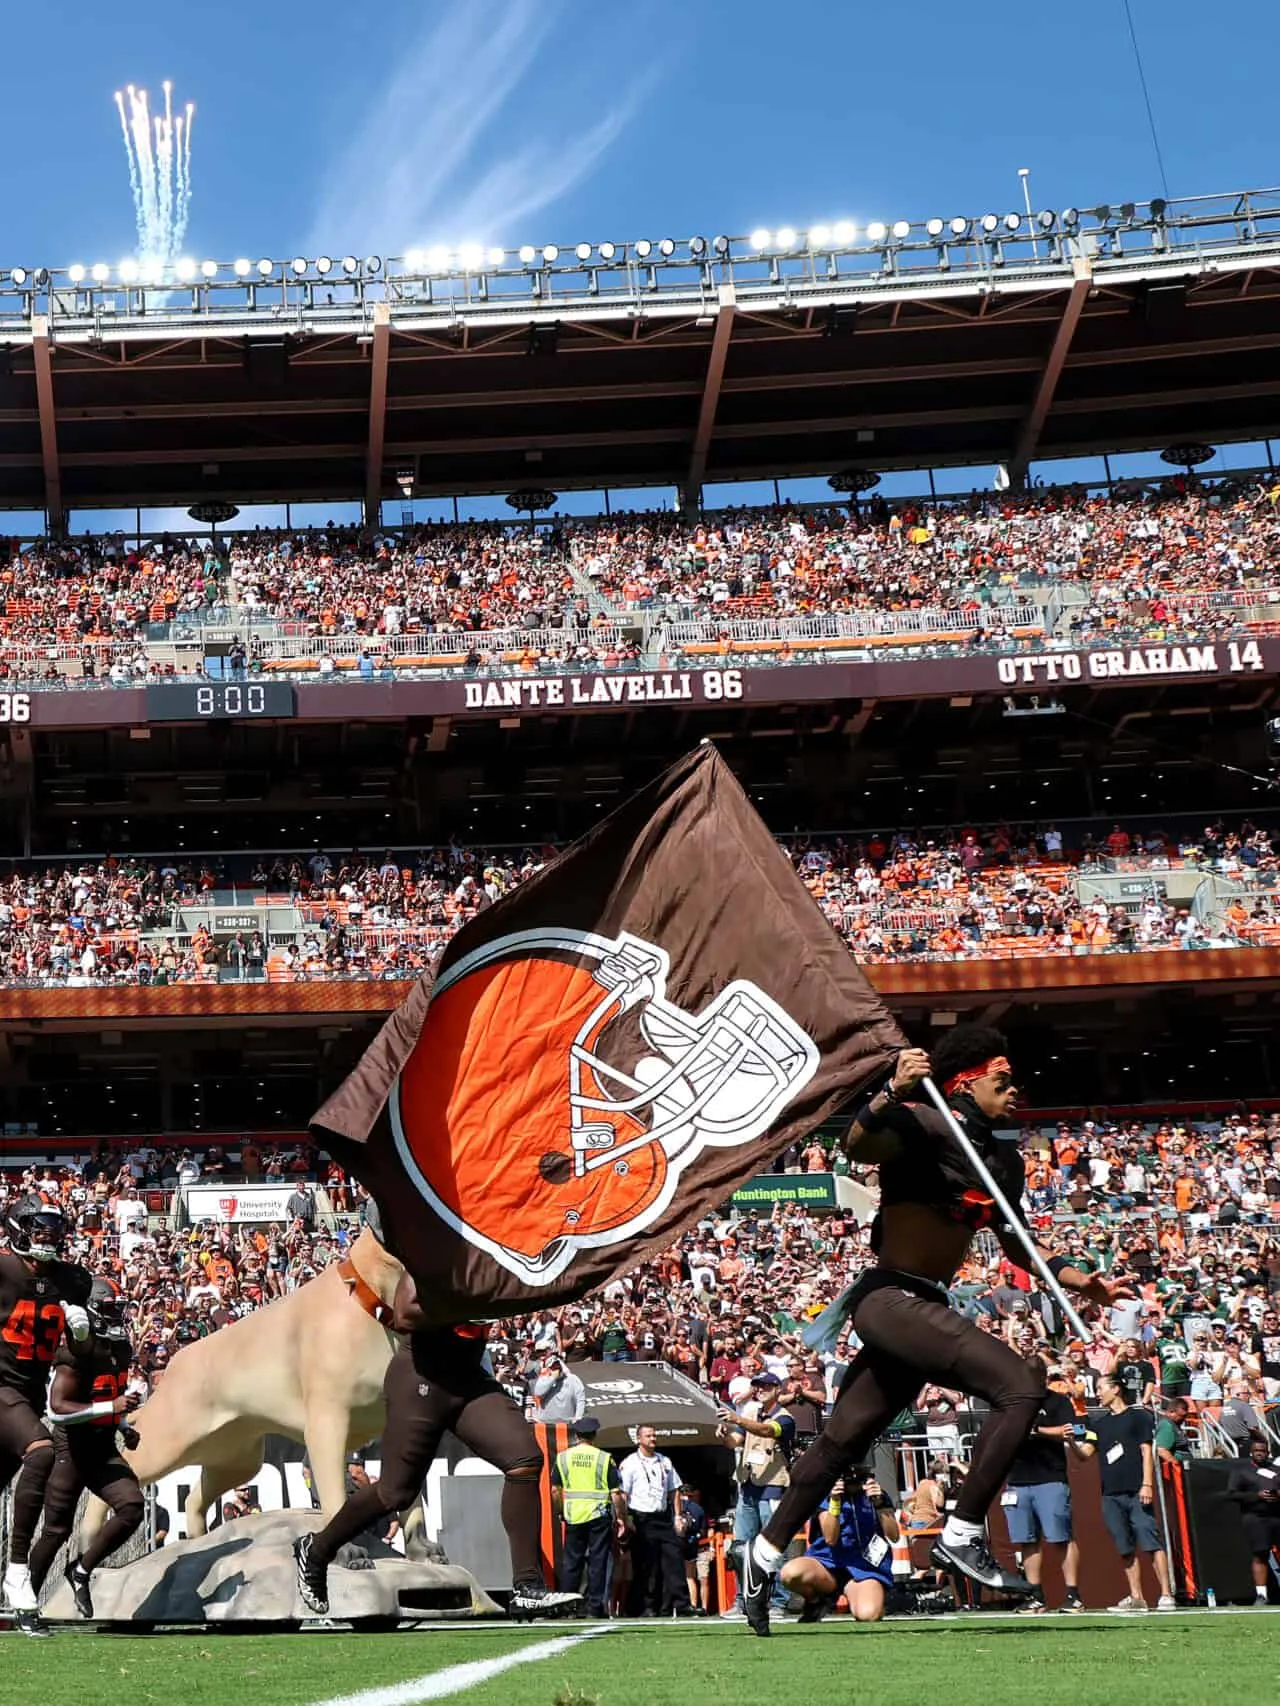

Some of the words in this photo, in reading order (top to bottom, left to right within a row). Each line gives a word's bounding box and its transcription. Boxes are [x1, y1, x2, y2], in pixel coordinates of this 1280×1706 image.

[997, 654, 1082, 683] OTTO
[1089, 645, 1218, 677] GRAHAM
[1228, 641, 1264, 672] 14
[197, 686, 265, 715] 8:00
[465, 680, 564, 709] DANTE
[572, 674, 692, 704] LAVELLI
[703, 670, 743, 700] 86
[240, 1200, 282, 1210] University
[797, 1187, 828, 1199] Bank
[240, 1210, 280, 1218] Hospitals
[1, 1299, 65, 1361] 43
